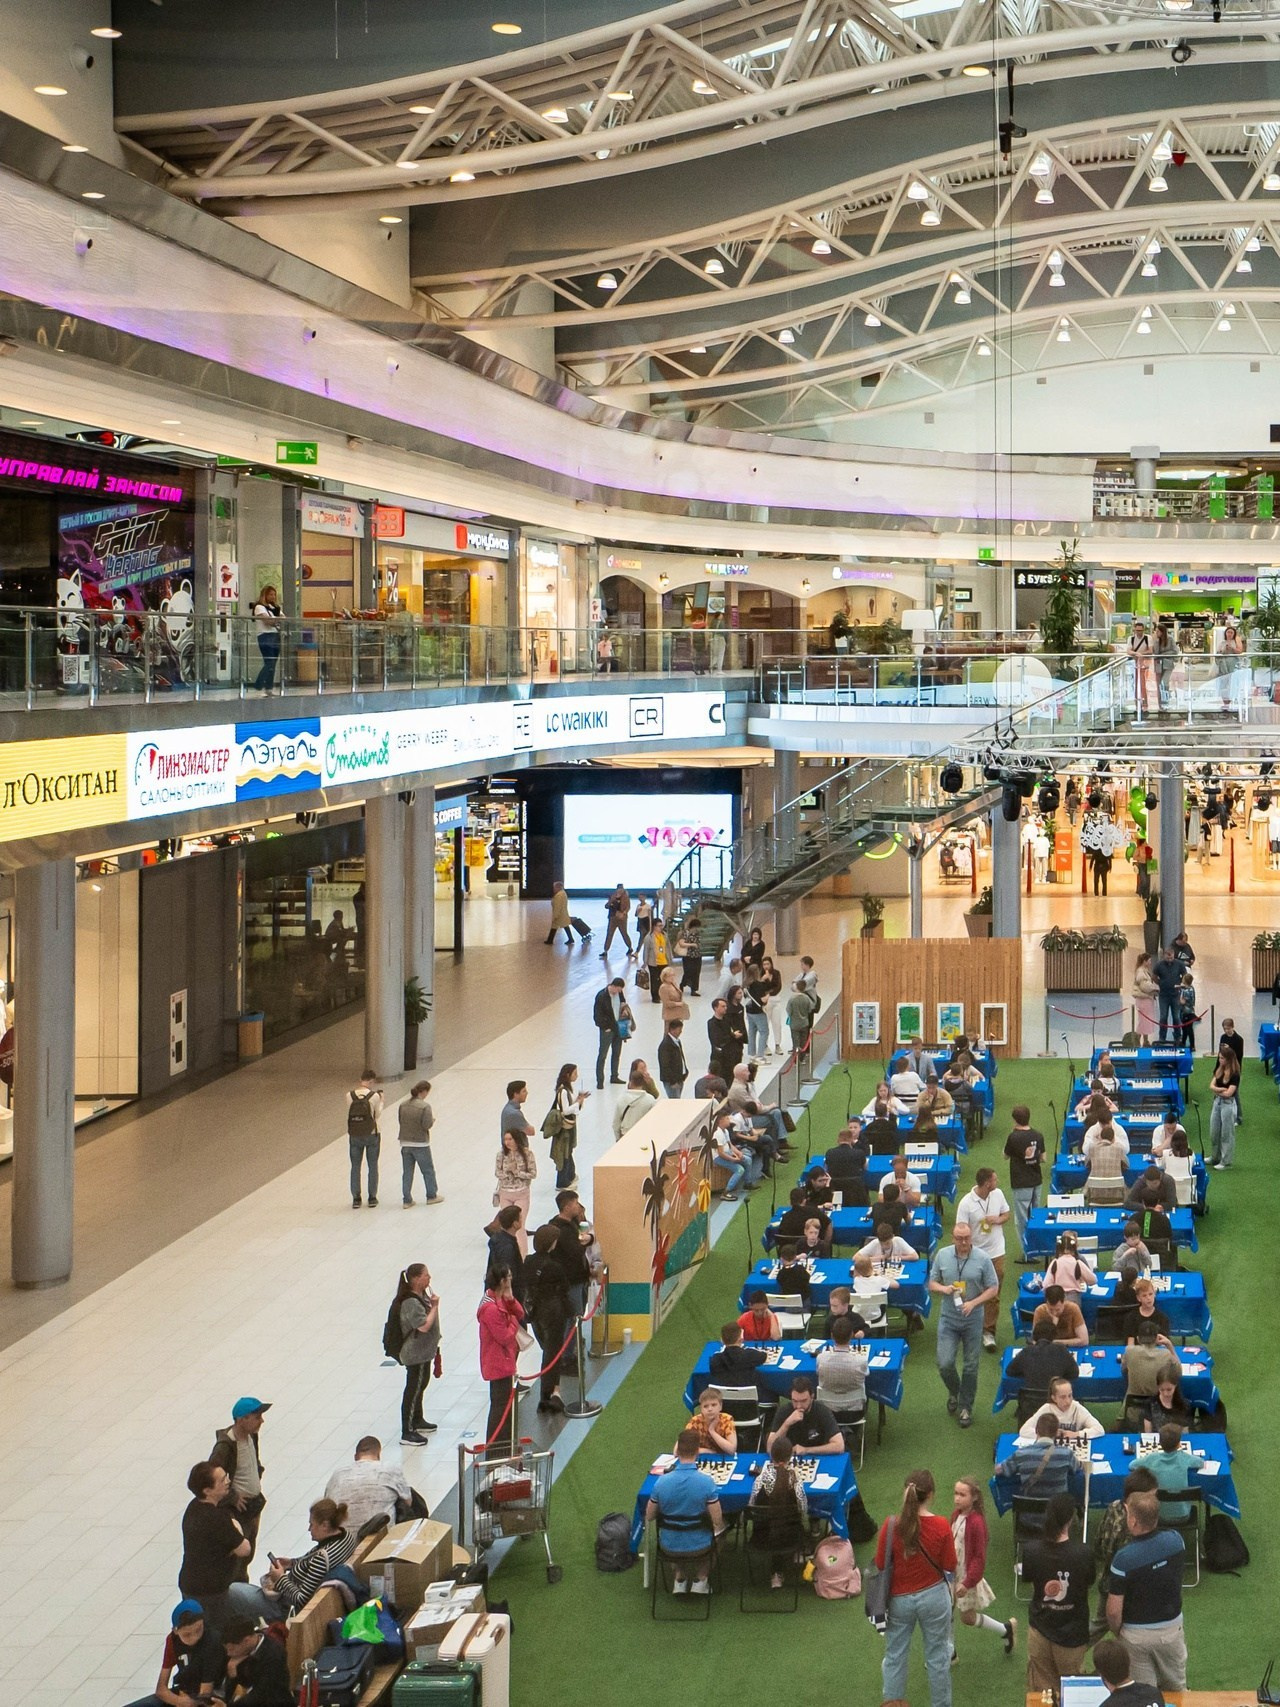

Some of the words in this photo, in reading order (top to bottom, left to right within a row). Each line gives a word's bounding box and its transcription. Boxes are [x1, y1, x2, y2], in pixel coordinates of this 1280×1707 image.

[0, 457, 99, 489] УПРАВЛЯЙ
[104, 476, 183, 502] ЗАНОСОМ
[546, 713, 560, 733] LC
[634, 708, 659, 726] CR
[157, 748, 231, 781] ЛИНЗМАСТЕР
[326, 731, 390, 779] Столетов
[140, 788, 183, 806] САЛОНЫ
[186, 781, 226, 799] ОПТИКИ
[440, 806, 463, 825] COFFEE
